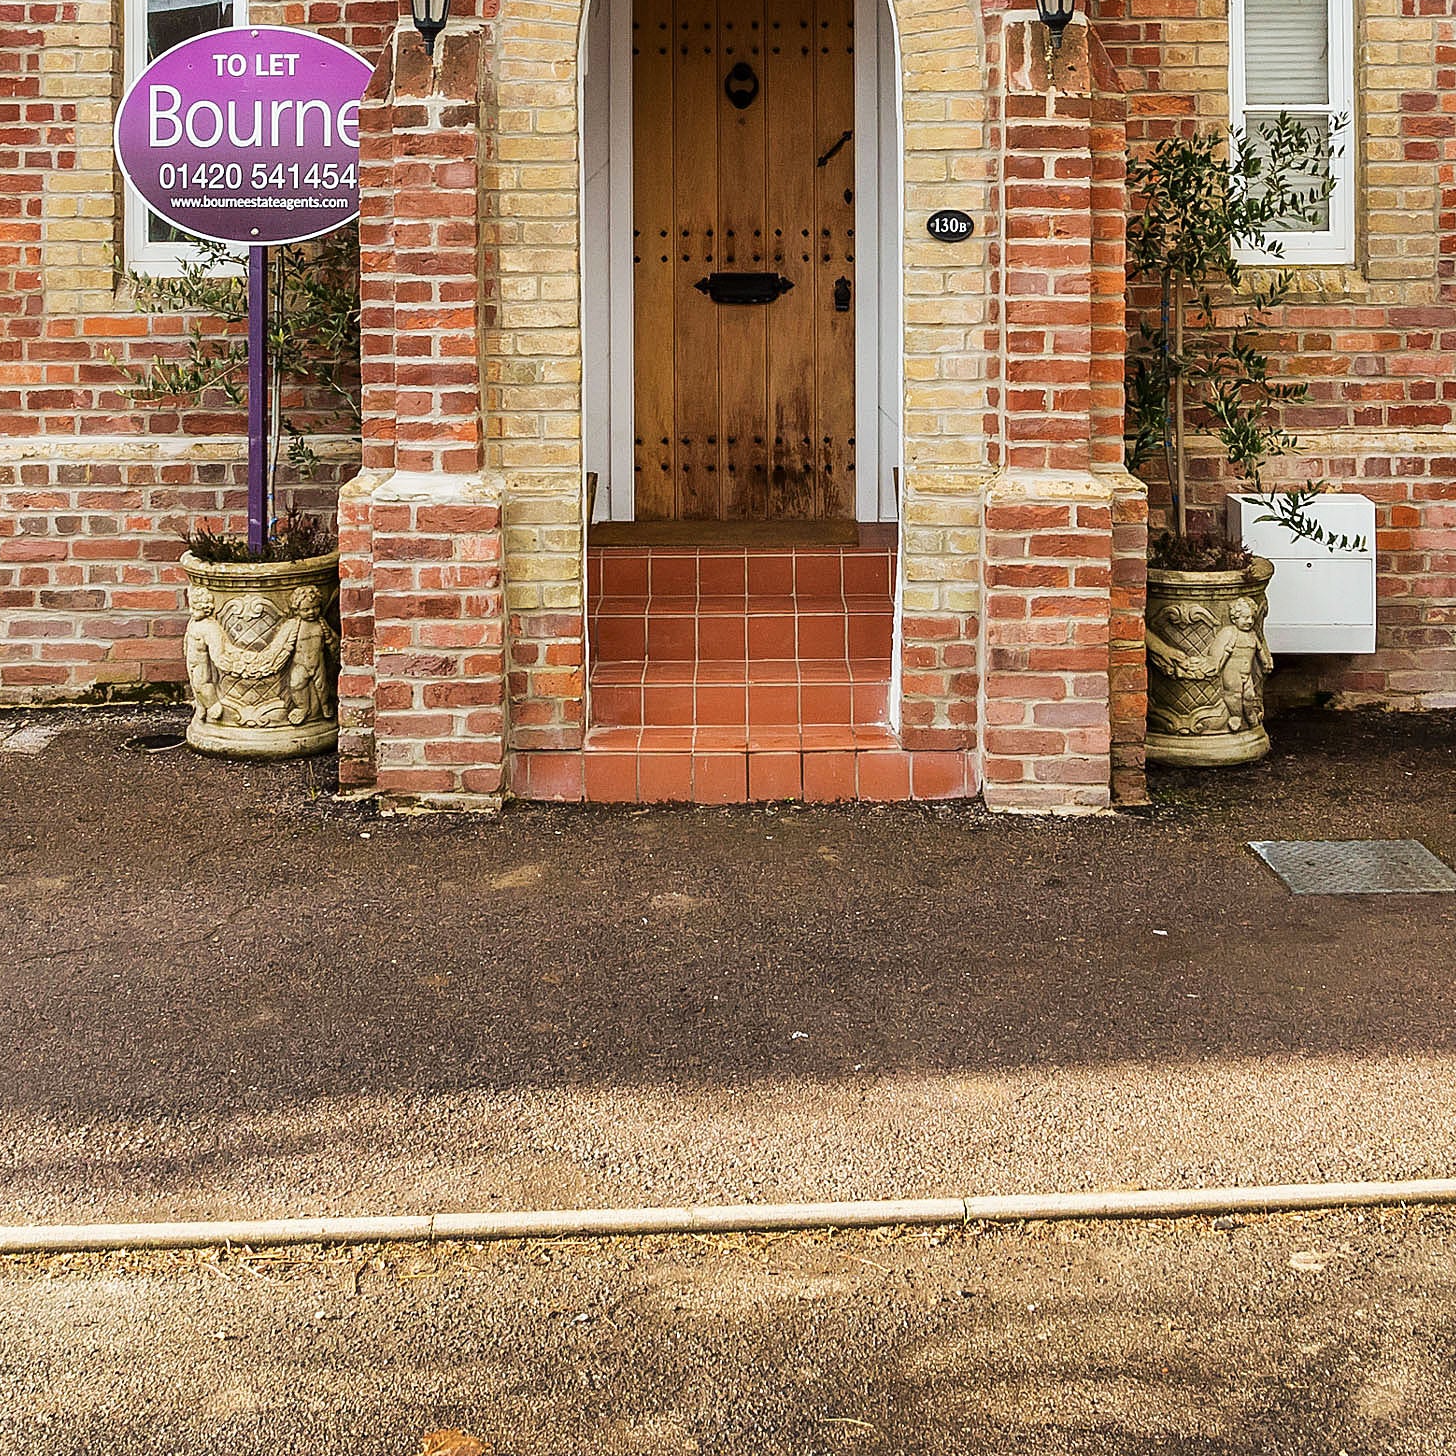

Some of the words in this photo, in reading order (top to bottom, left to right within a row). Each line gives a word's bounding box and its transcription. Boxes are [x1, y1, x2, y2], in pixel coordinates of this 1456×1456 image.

[212, 53, 247, 77] TO
[254, 53, 301, 77] LET
[148, 84, 361, 149] Bourne
[158, 162, 244, 190] 01420
[249, 162, 359, 190] 541454
[170, 195, 349, 211] www.bourneestateagents.com
[934, 217, 968, 234] 130B
